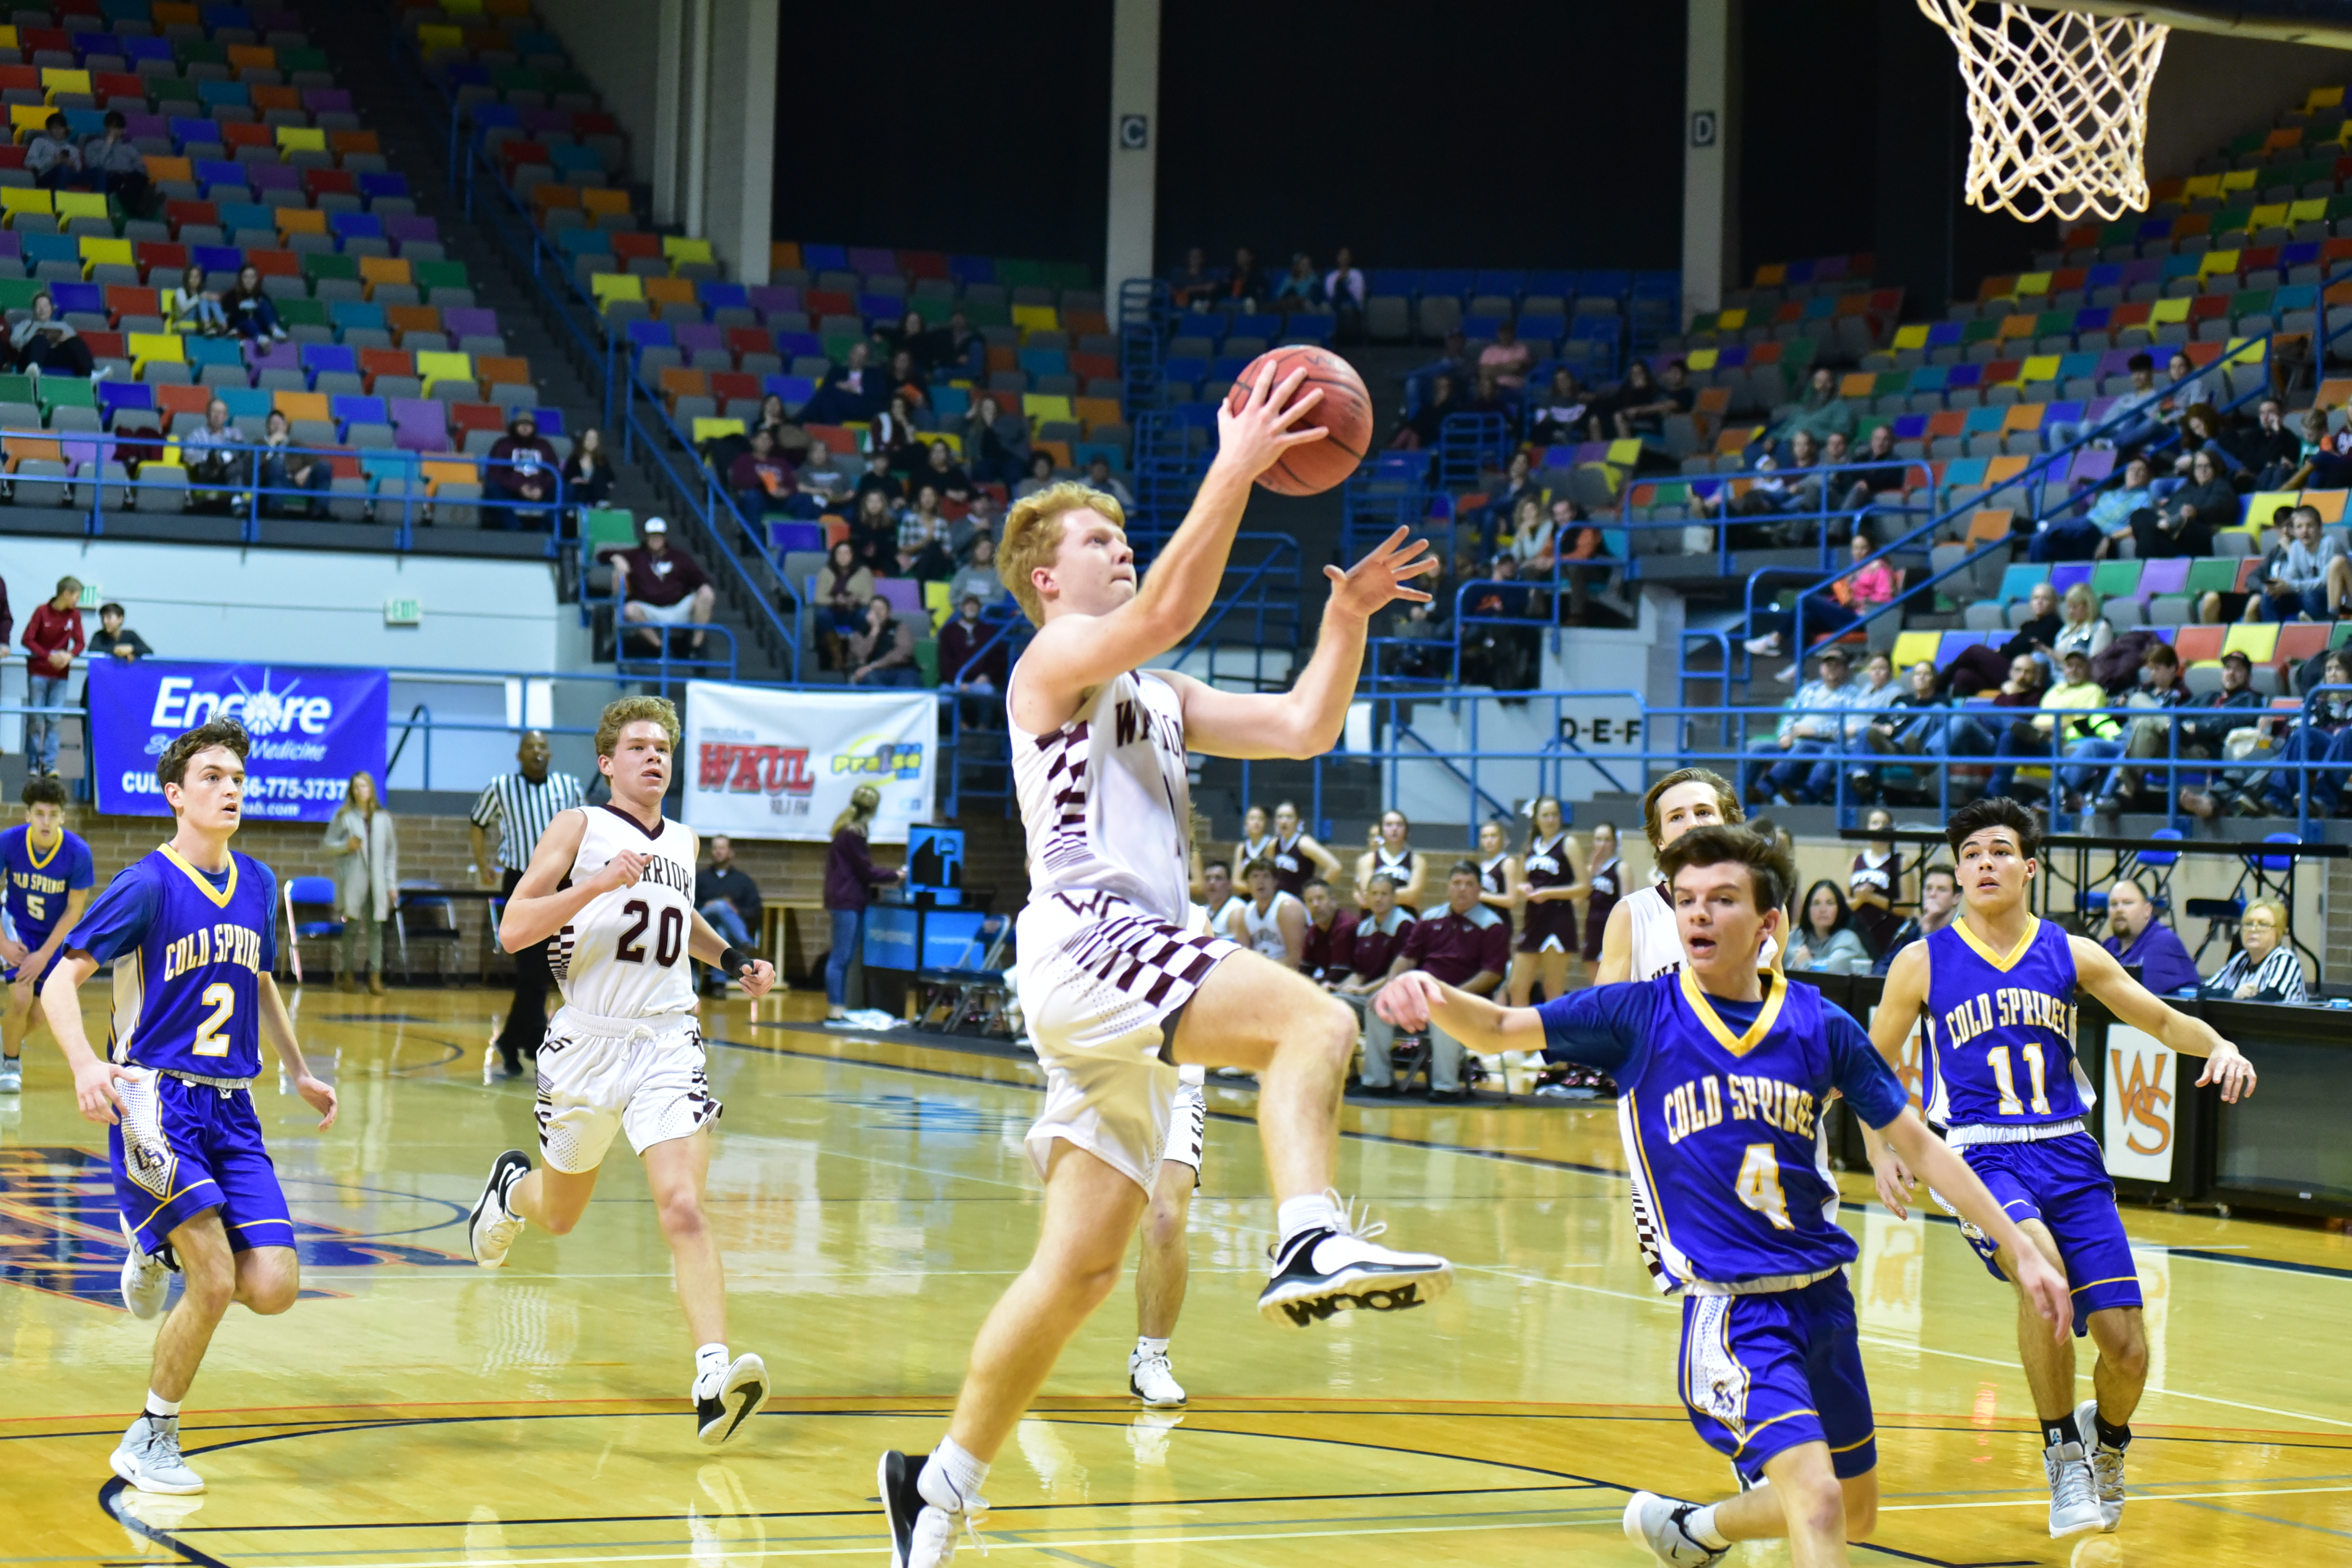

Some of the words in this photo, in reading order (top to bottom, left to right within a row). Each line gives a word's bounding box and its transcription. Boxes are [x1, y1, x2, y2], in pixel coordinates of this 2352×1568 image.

[1123, 118, 1144, 145] C
[1695, 115, 1712, 142] D
[1560, 718, 1642, 744] D-E-F
[698, 742, 815, 796] WKUL
[27, 893, 45, 921] 5
[614, 897, 684, 970] 20
[165, 928, 210, 982] COLD
[214, 923, 261, 978] SPRING
[192, 983, 235, 1057] 2
[1946, 993, 1994, 1049] COLD
[1987, 1043, 2052, 1115] 11
[1664, 1075, 1722, 1145] COLD
[1735, 1143, 1795, 1231] 4
